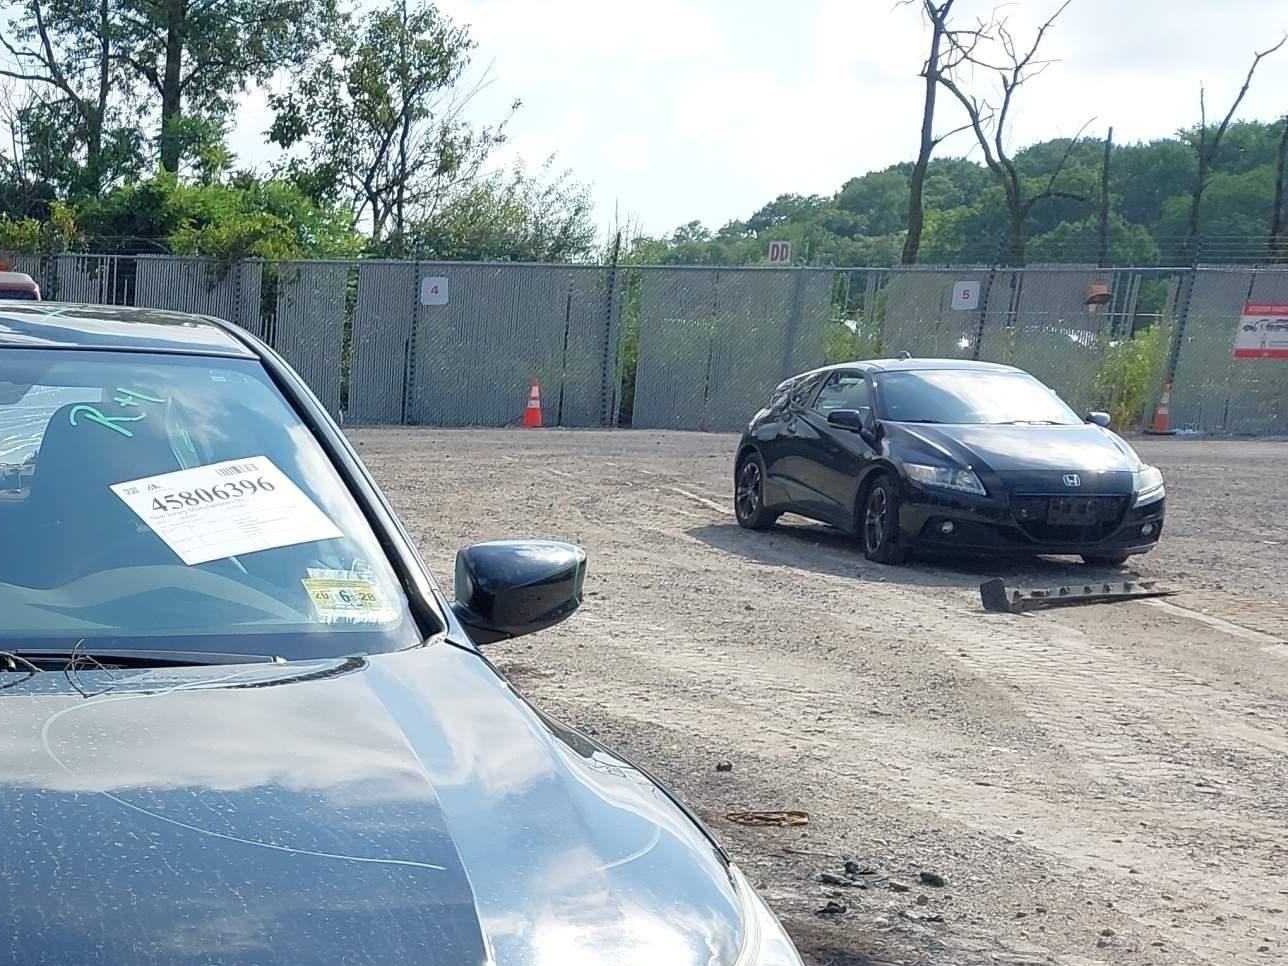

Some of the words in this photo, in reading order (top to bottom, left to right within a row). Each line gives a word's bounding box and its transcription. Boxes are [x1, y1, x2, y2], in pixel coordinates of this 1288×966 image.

[770, 243, 790, 262] DD
[430, 284, 440, 295] 4
[962, 289, 970, 300] 5
[151, 475, 276, 512] 45806396
[338, 589, 351, 603] 6
[358, 592, 377, 602] 28
